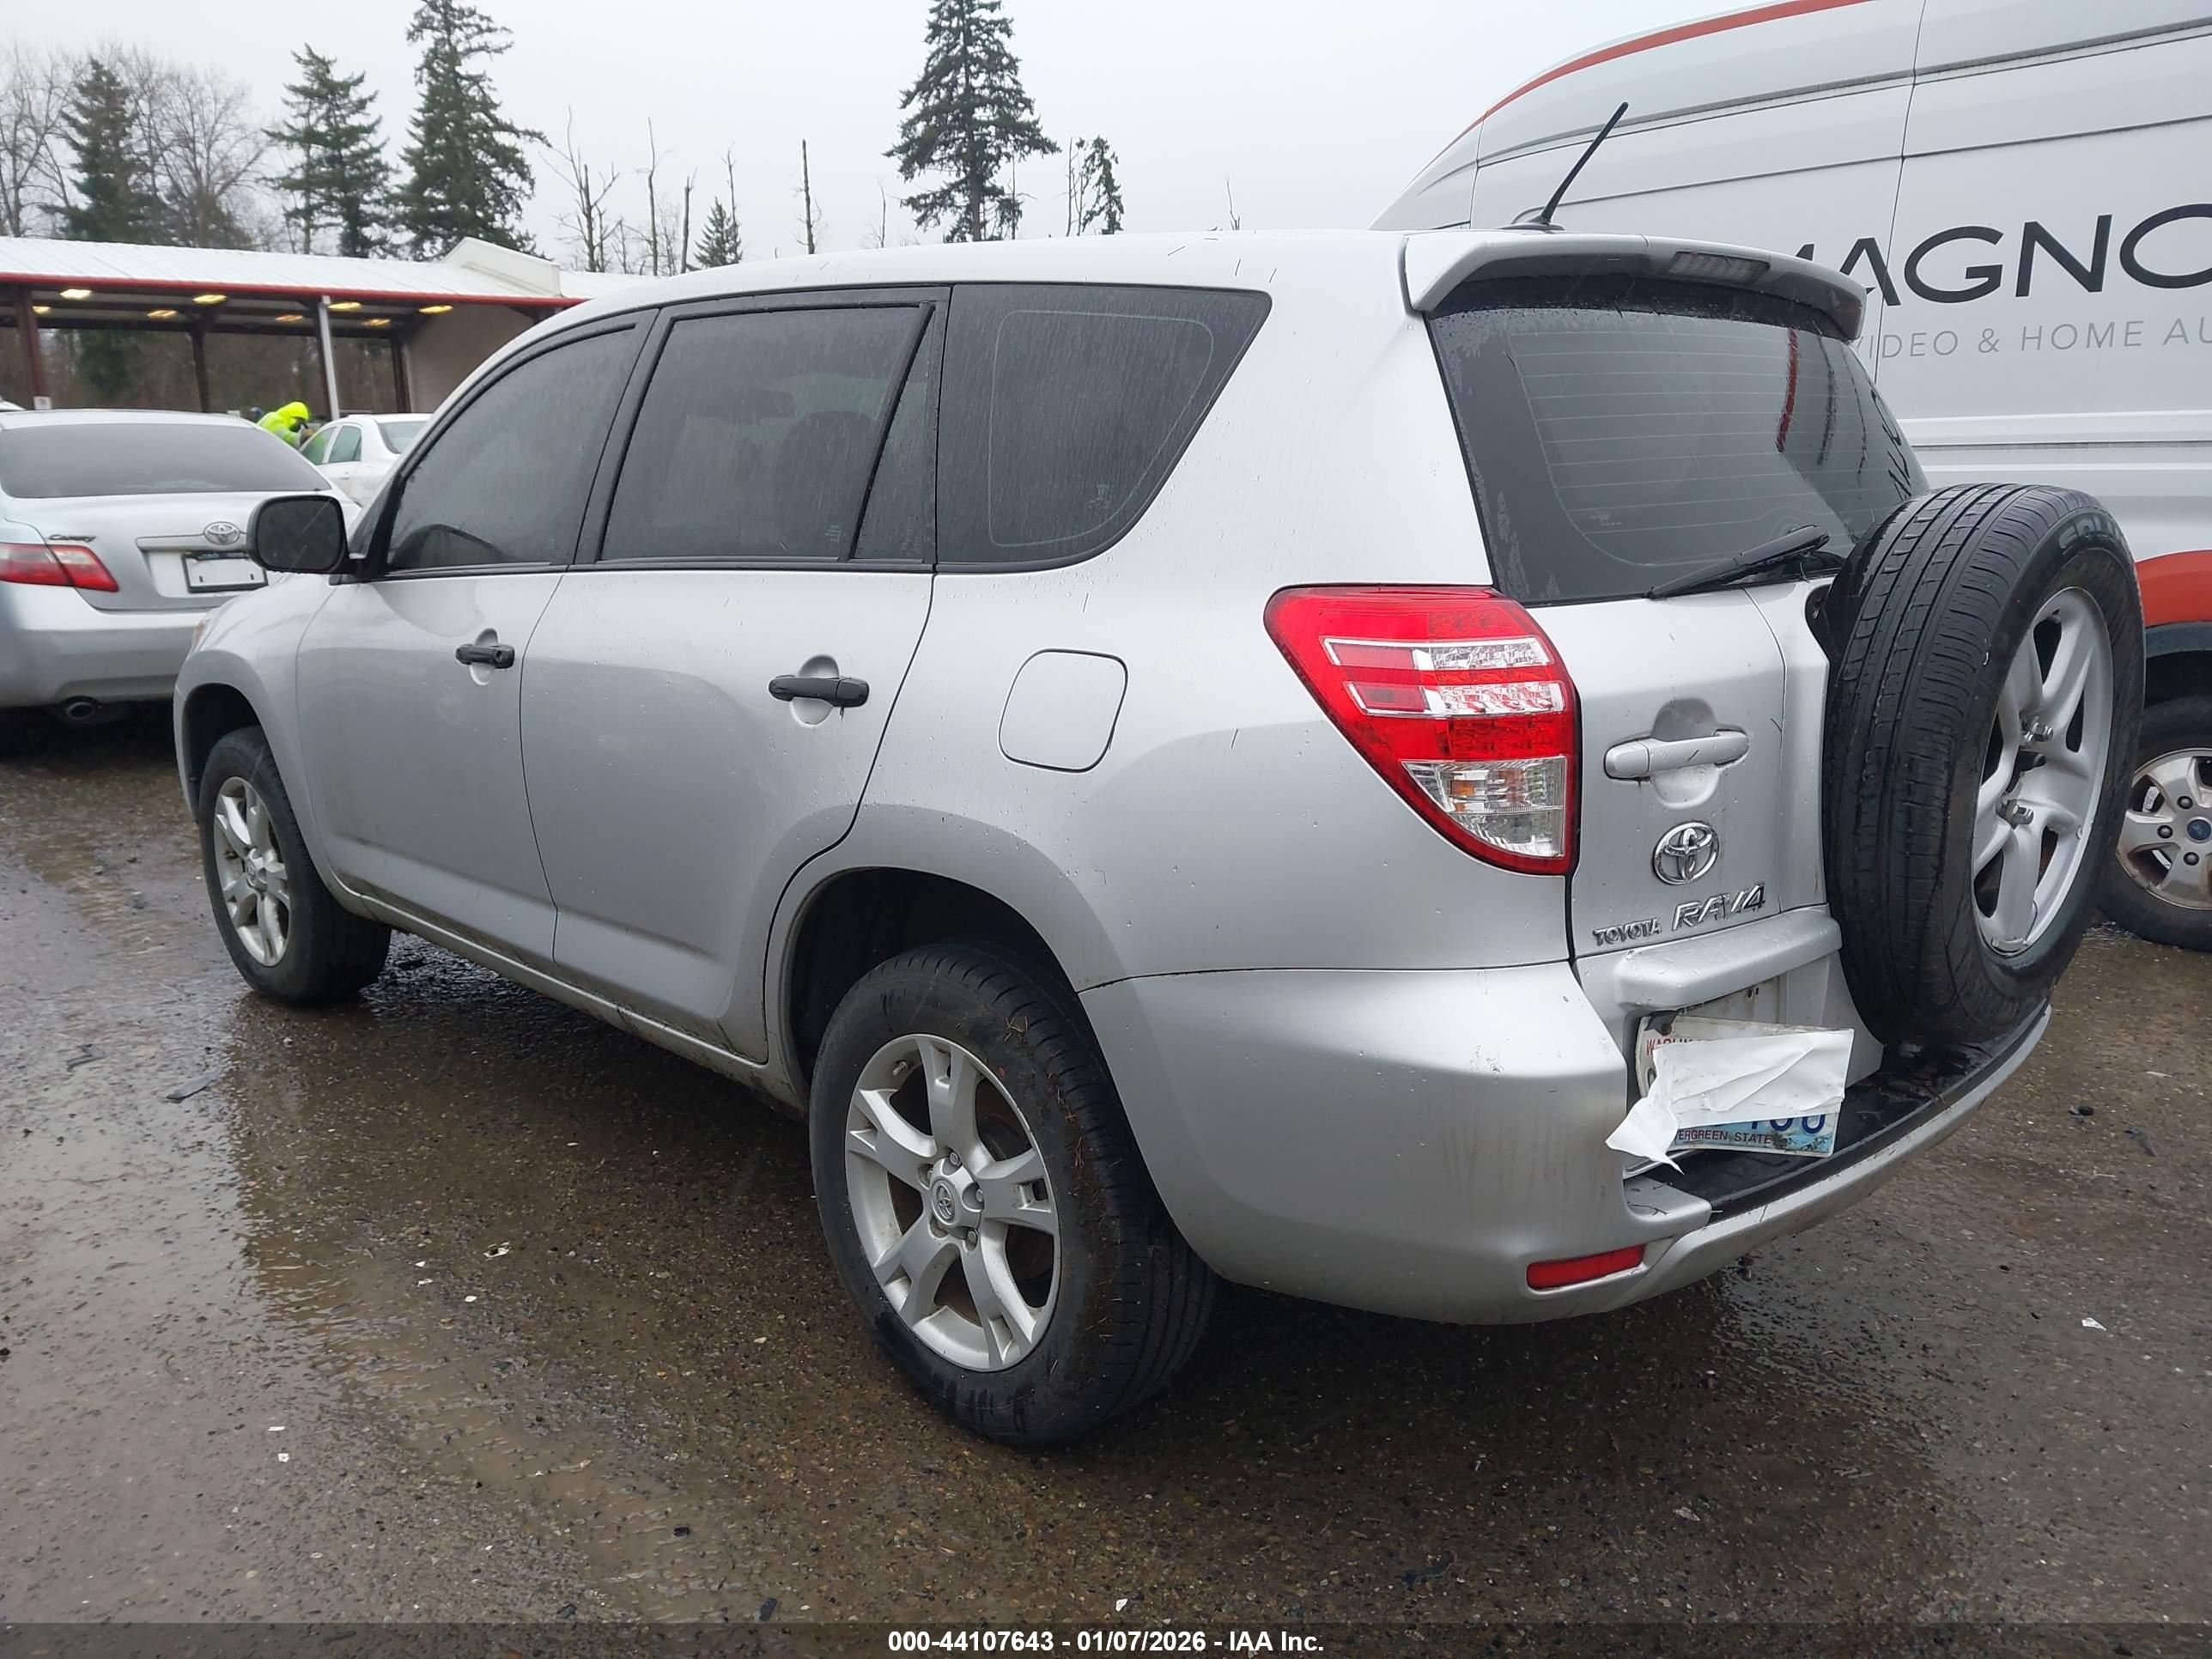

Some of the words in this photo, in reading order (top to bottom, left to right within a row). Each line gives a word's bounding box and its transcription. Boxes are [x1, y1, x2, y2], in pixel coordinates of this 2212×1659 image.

[1796, 203, 2212, 306] AGNO
[1856, 331, 1958, 359] IDEO
[1978, 328, 1999, 353] &
[2021, 320, 2143, 351] HOME
[1593, 918, 1662, 946] TOYOTA
[1672, 884, 1765, 932] RAV4
[1735, 1132, 1772, 1145] STATE
